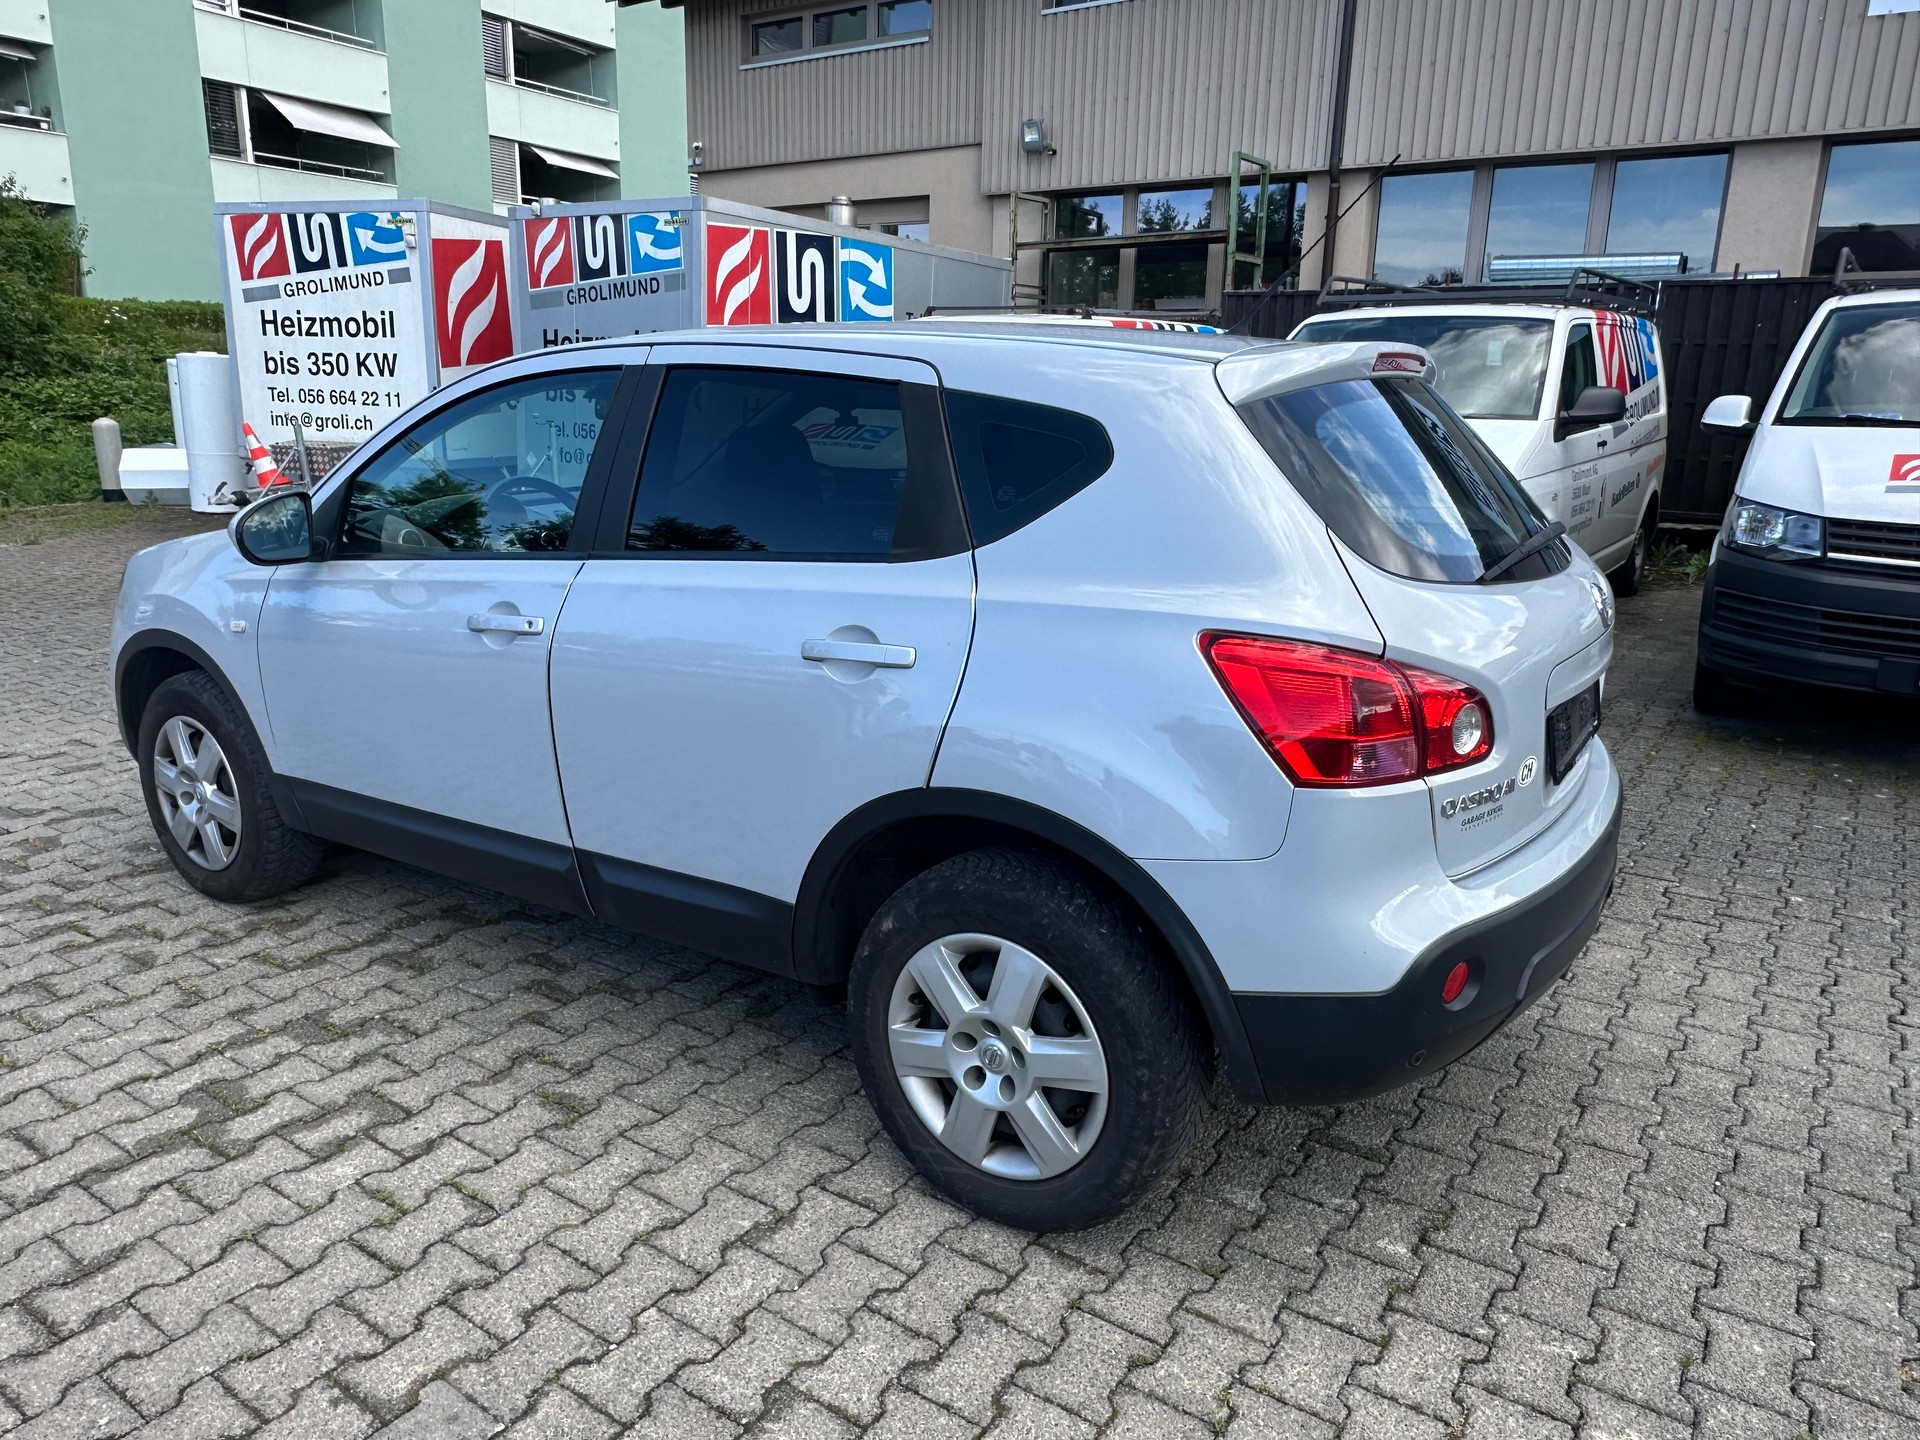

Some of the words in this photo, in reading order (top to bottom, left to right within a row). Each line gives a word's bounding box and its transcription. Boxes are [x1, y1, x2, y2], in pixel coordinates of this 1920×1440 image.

[283, 271, 385, 298] GROLIMUND
[566, 276, 660, 305] GROLIMUND
[260, 309, 396, 338] Heizmobil
[264, 351, 300, 375] bis
[307, 352, 349, 377] 350
[356, 352, 398, 377] KW
[267, 387, 294, 404] Tel.
[298, 387, 324, 405] 056
[329, 389, 355, 406] 664
[360, 390, 379, 407] 22
[384, 392, 402, 408] 11
[270, 410, 373, 432] info@groli.ch
[1520, 761, 1534, 781] CH
